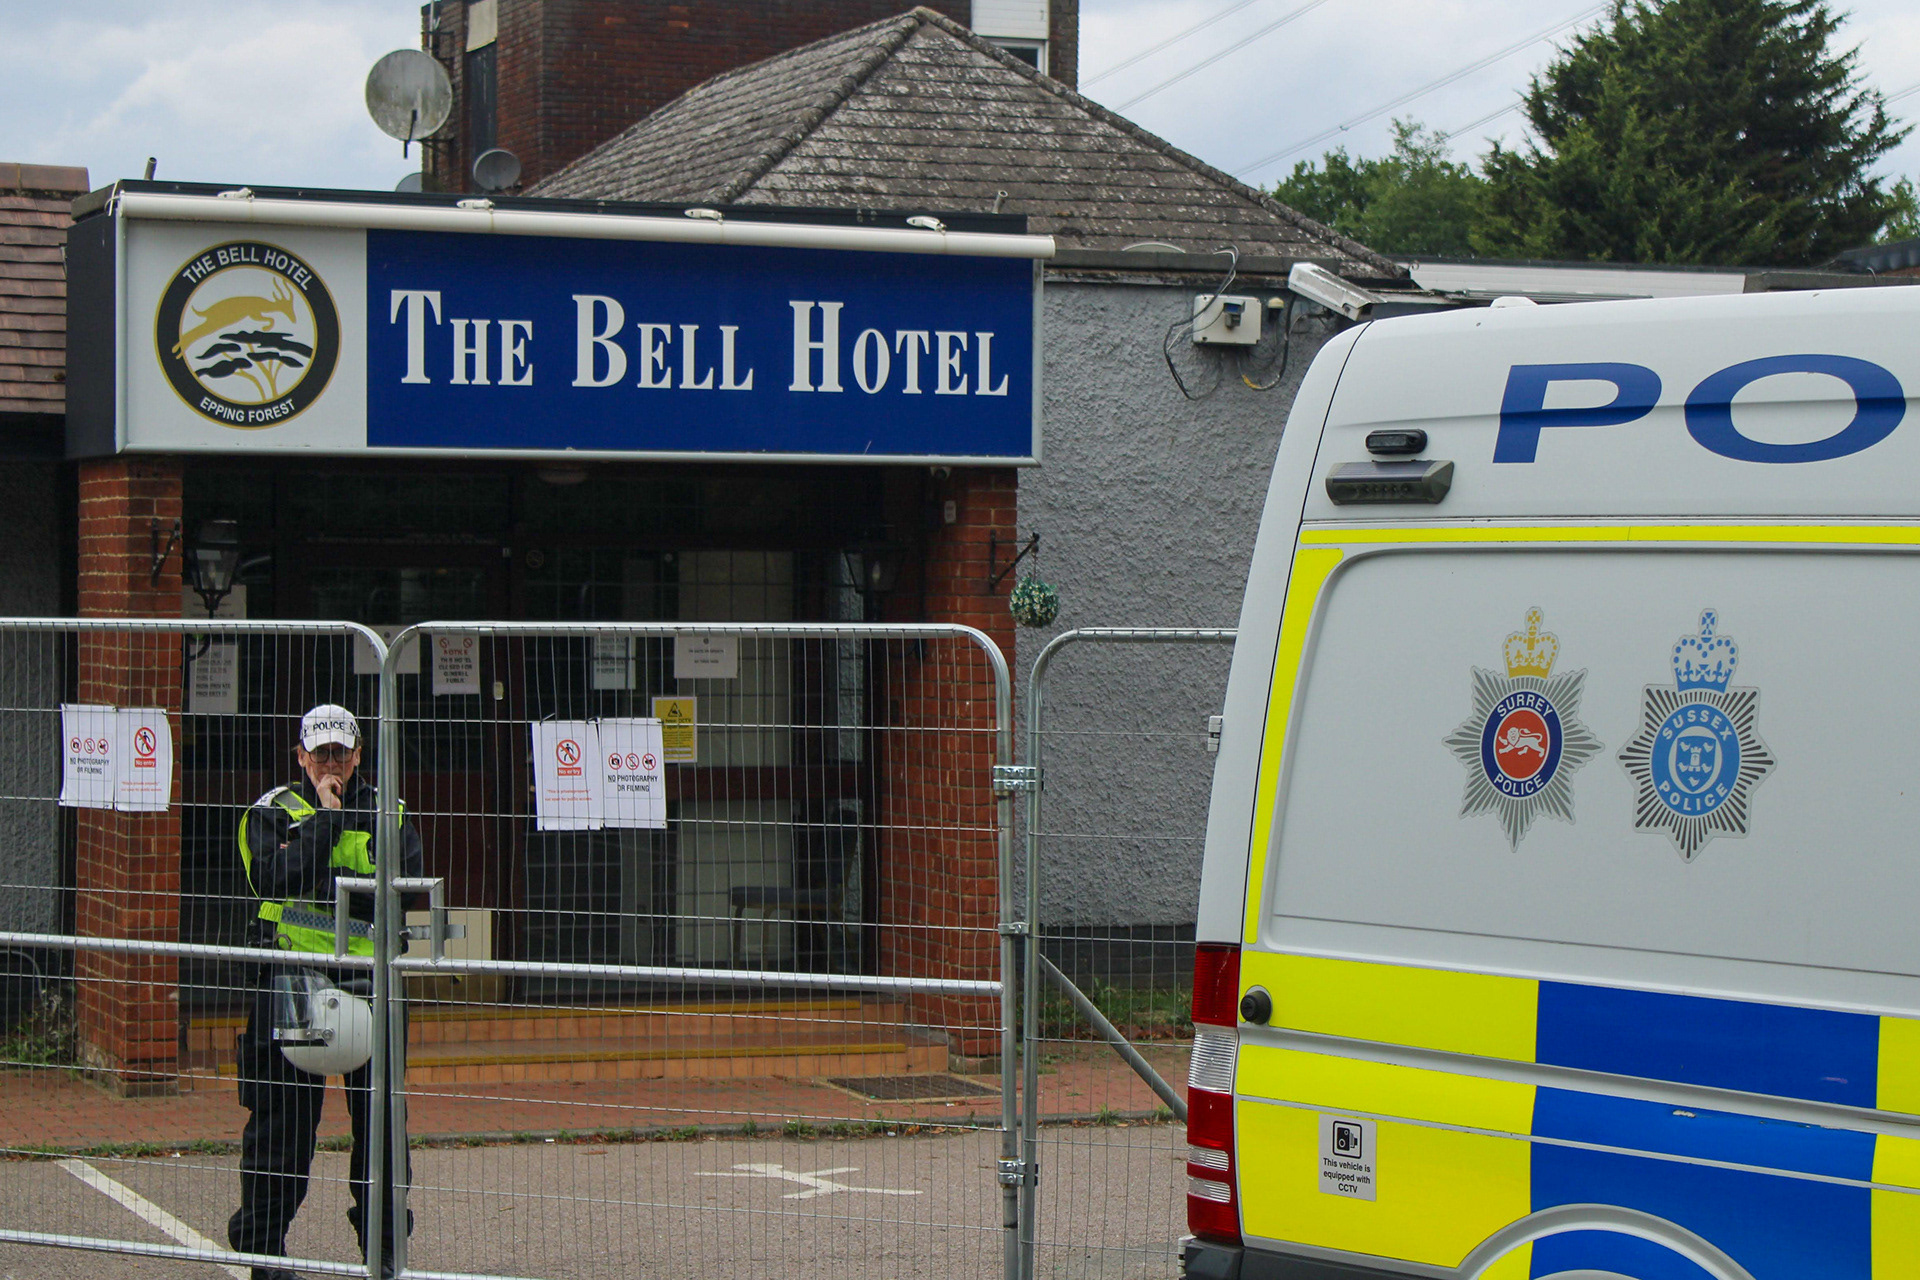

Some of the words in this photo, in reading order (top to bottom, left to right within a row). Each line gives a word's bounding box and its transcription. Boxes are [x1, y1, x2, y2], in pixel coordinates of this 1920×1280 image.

[183, 255, 216, 284] THE
[216, 247, 260, 266] BELL
[264, 249, 314, 291] HOTEL
[200, 396, 245, 422] EPPING
[249, 399, 296, 422] FOREST
[1496, 694, 1553, 718] SURREY
[312, 721, 345, 732] POLICE
[1662, 709, 1732, 742] SUSSEX
[77, 757, 110, 766] PHOTOGRAPHY
[84, 767, 102, 775] FILMING
[617, 774, 658, 782] PHOTOGRAPHY
[626, 784, 650, 792] FILMING
[1493, 773, 1545, 795] POLICE
[1658, 782, 1728, 811] POLICE
[1323, 1157, 1338, 1168] This
[1339, 1160, 1363, 1171] vehicle
[1364, 1164, 1371, 1172] is
[1323, 1170, 1355, 1182] equipped
[1356, 1175, 1371, 1184] with
[1338, 1183, 1358, 1193] CCTV
